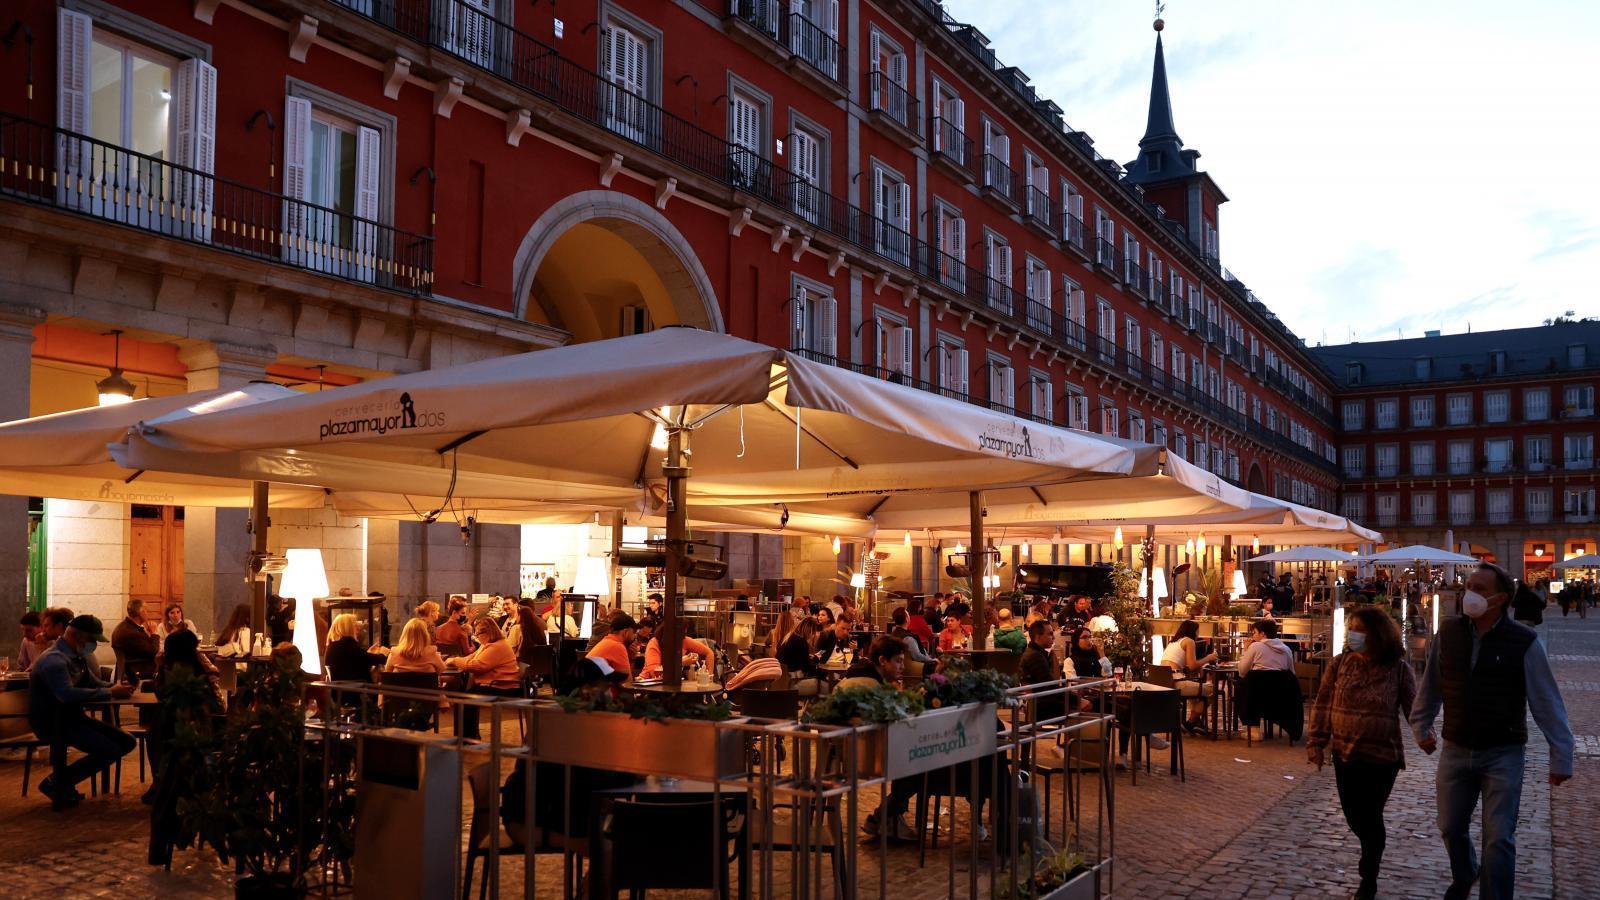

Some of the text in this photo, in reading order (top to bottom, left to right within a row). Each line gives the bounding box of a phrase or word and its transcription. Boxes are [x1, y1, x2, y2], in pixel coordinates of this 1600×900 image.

[320, 410, 446, 440] plazamayor dos
[978, 432, 1024, 457] plazamayor
